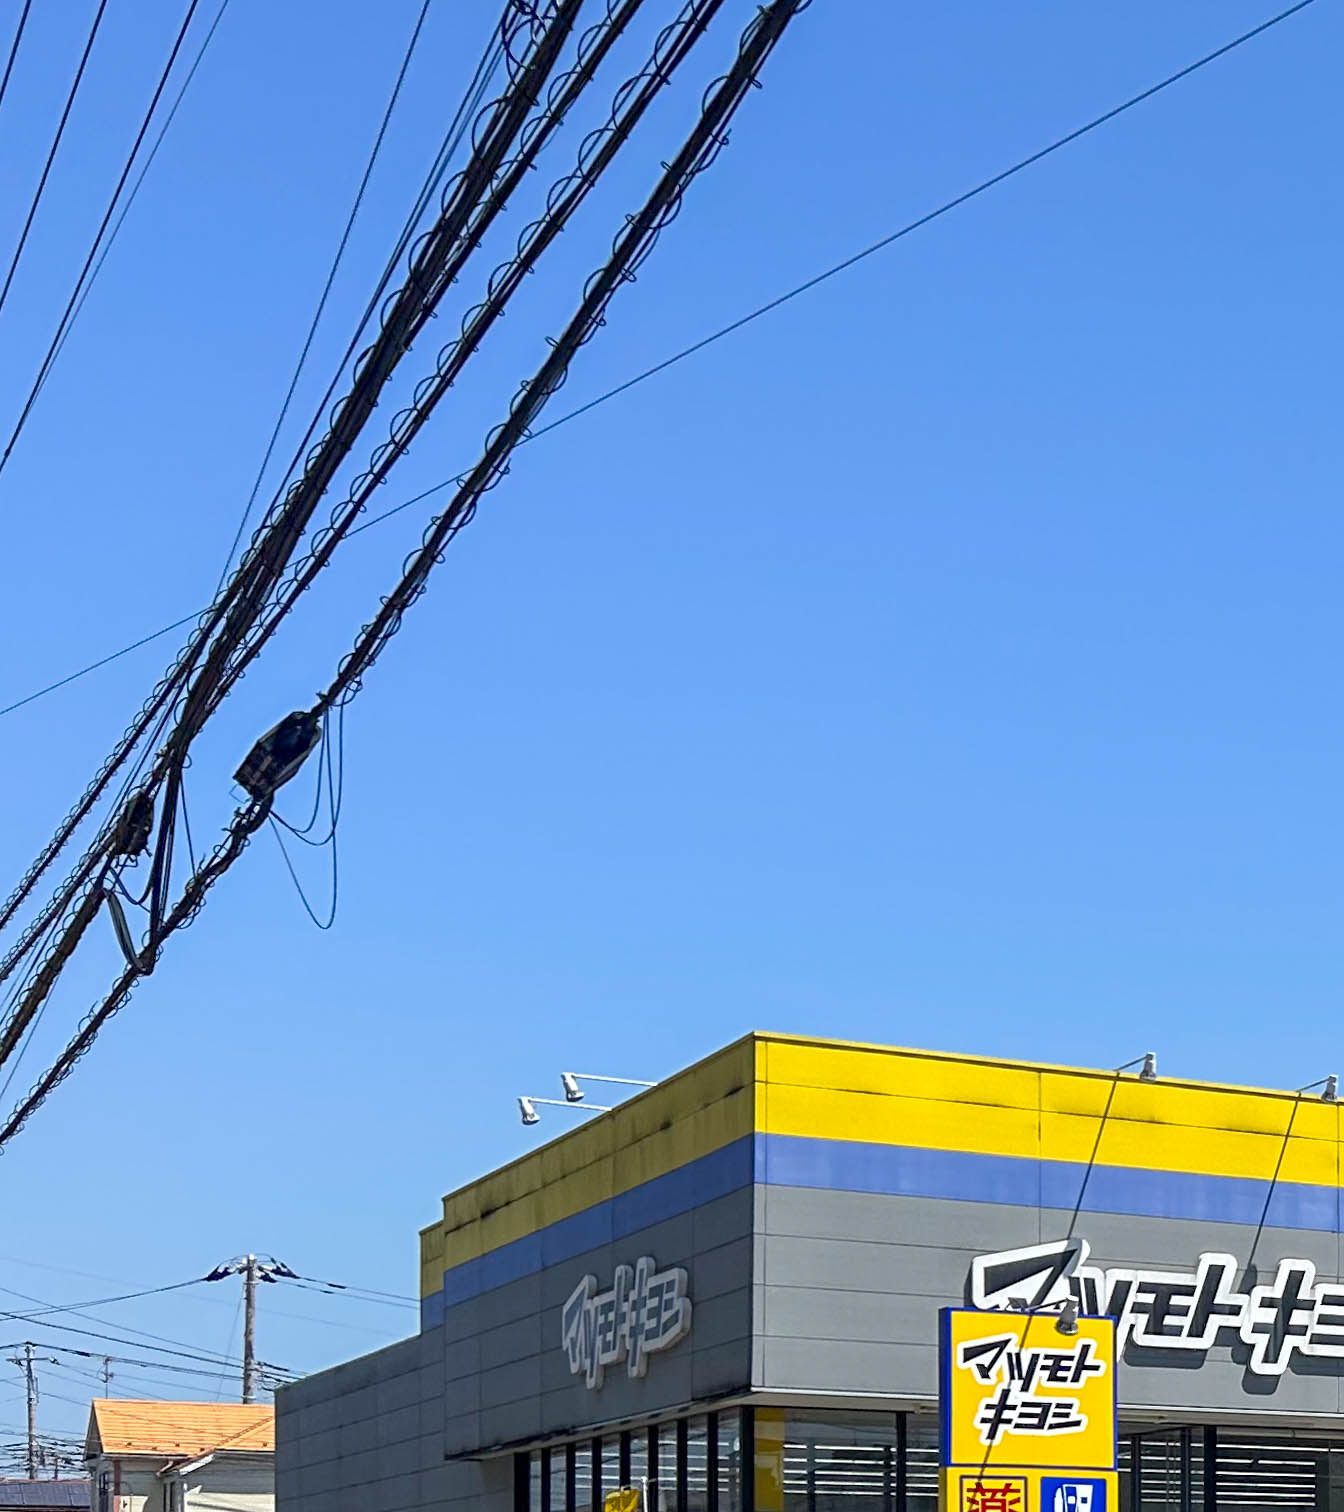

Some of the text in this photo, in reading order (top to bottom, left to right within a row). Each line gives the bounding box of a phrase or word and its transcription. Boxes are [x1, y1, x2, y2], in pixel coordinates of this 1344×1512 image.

[563, 1262, 685, 1384] マツモトキヨシ
[962, 1337, 1101, 1393] マツモト
[980, 1388, 1083, 1440] キヨシ
